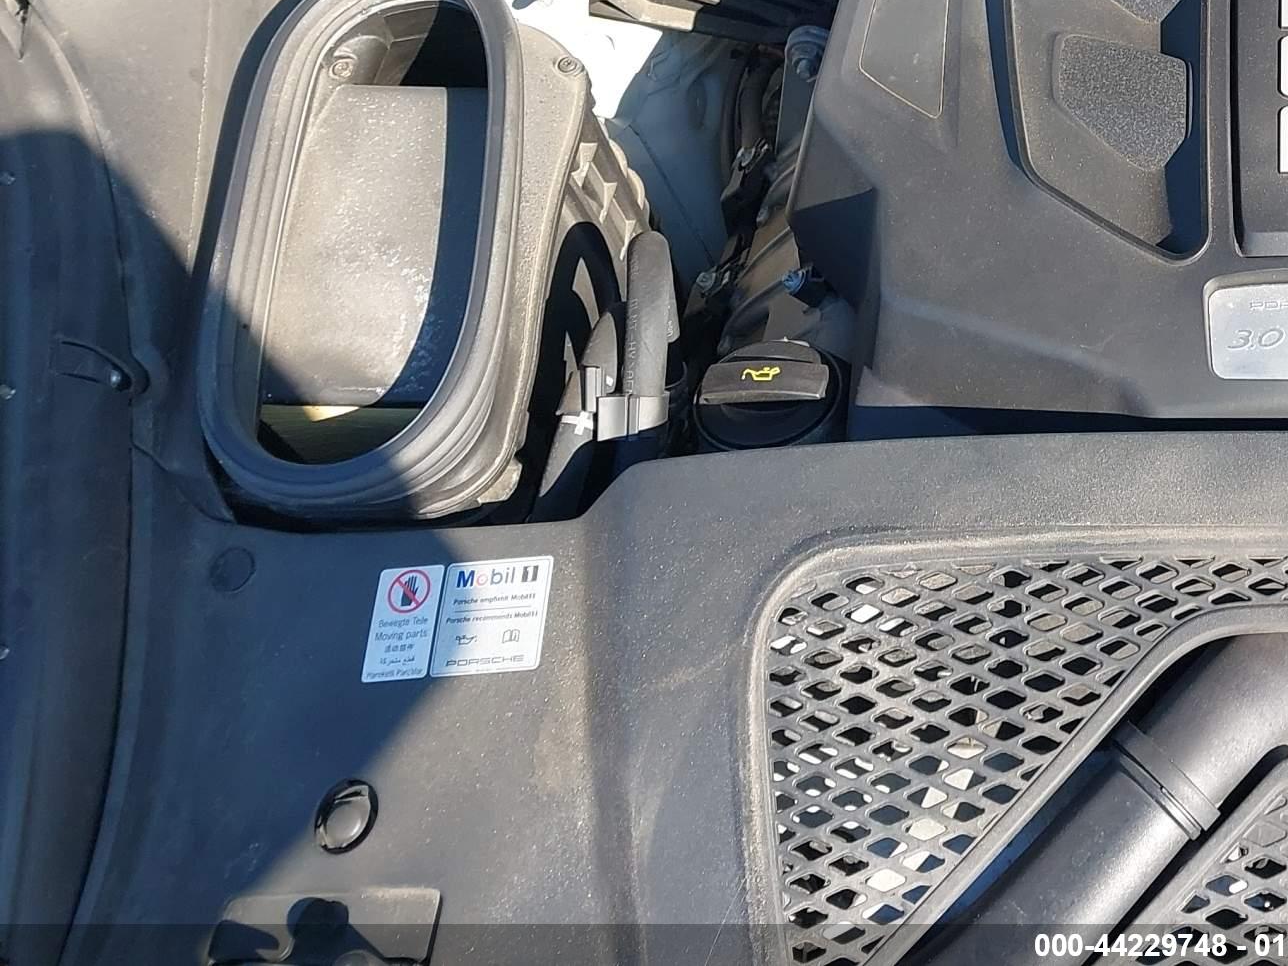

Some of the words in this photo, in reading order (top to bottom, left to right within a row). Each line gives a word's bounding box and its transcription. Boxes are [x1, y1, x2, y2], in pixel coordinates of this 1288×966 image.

[1227, 328, 1285, 350] 3.0
[456, 566, 517, 589] Mobil
[375, 631, 404, 642] Moving
[406, 629, 428, 640] parts
[446, 654, 525, 667] PORSCHE
